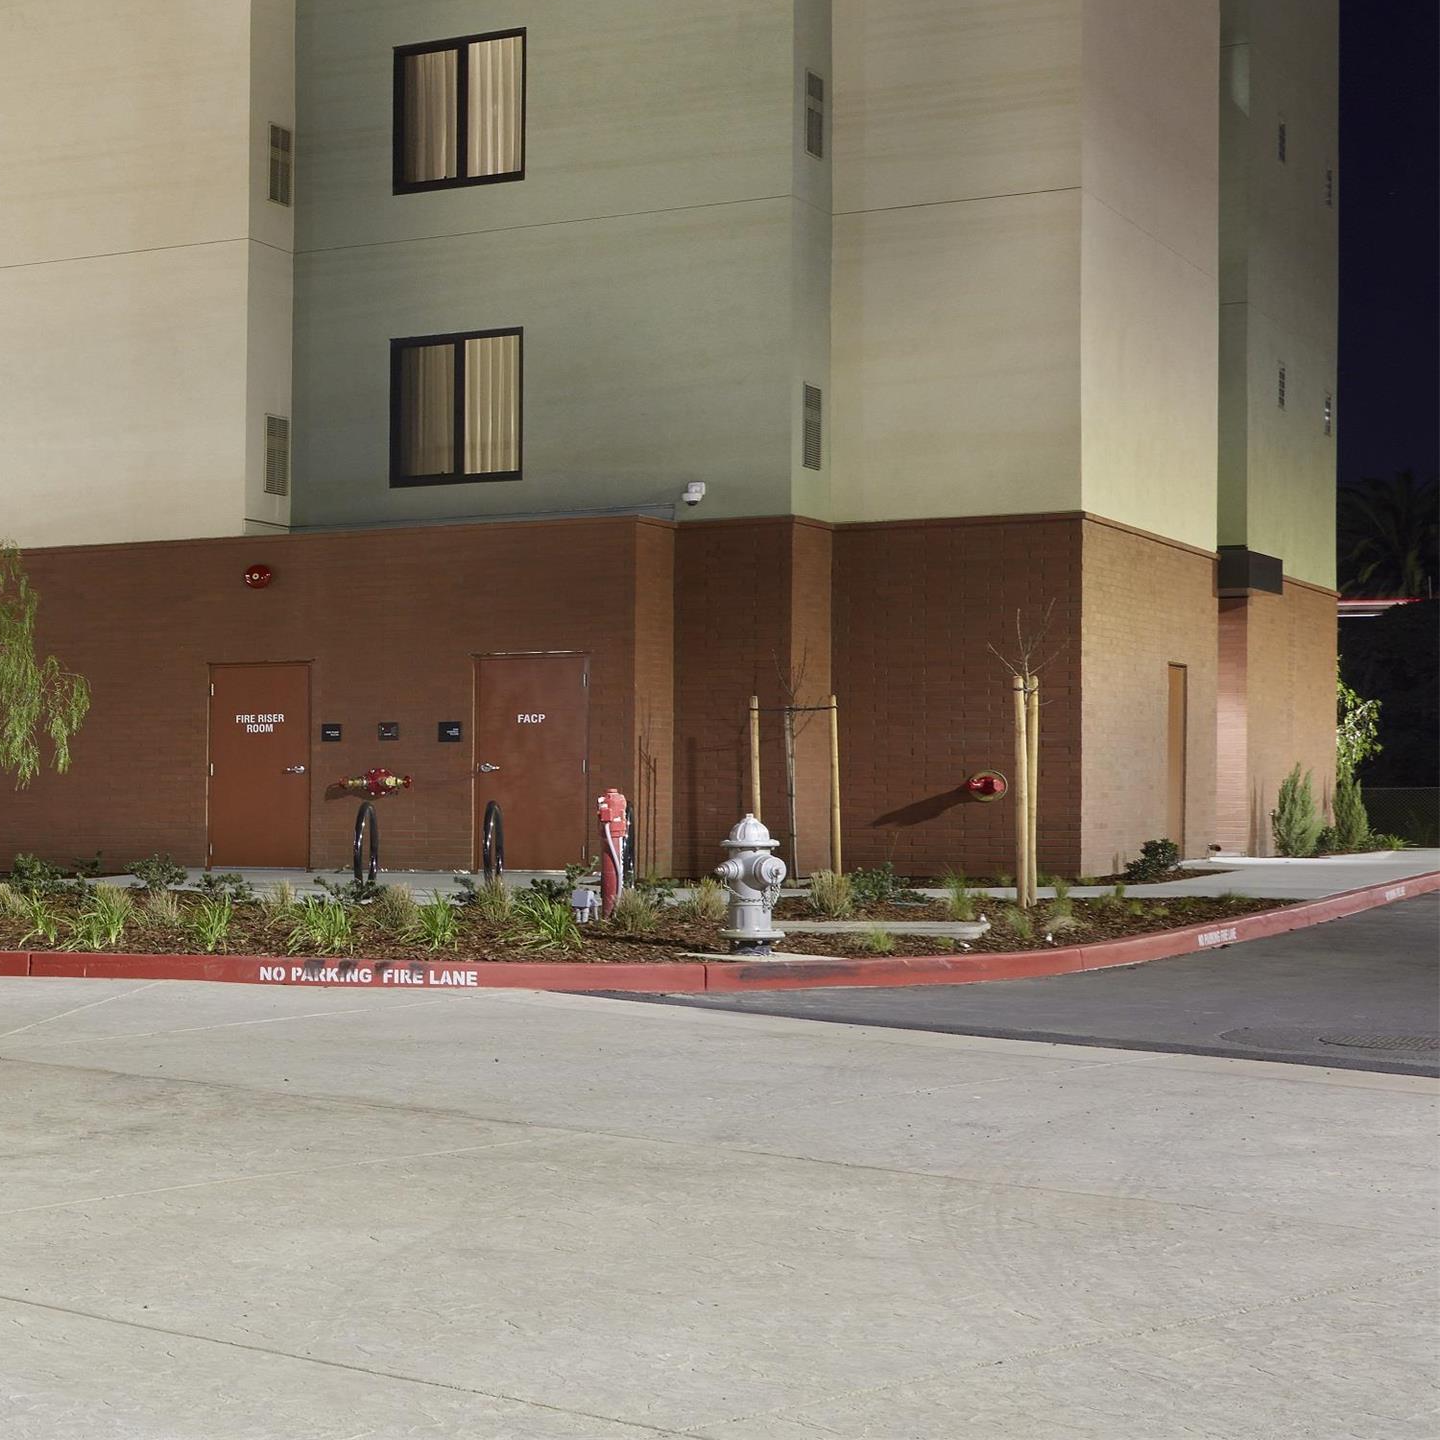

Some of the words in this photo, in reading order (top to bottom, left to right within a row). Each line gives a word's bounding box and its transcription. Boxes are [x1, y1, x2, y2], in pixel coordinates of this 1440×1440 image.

[235, 714, 256, 723] FIRE
[257, 713, 285, 723] RISER
[517, 713, 546, 724] FACP
[246, 723, 274, 733] ROOM
[259, 966, 286, 981] NO
[382, 969, 424, 984] FIRE
[429, 970, 478, 986] LANE
